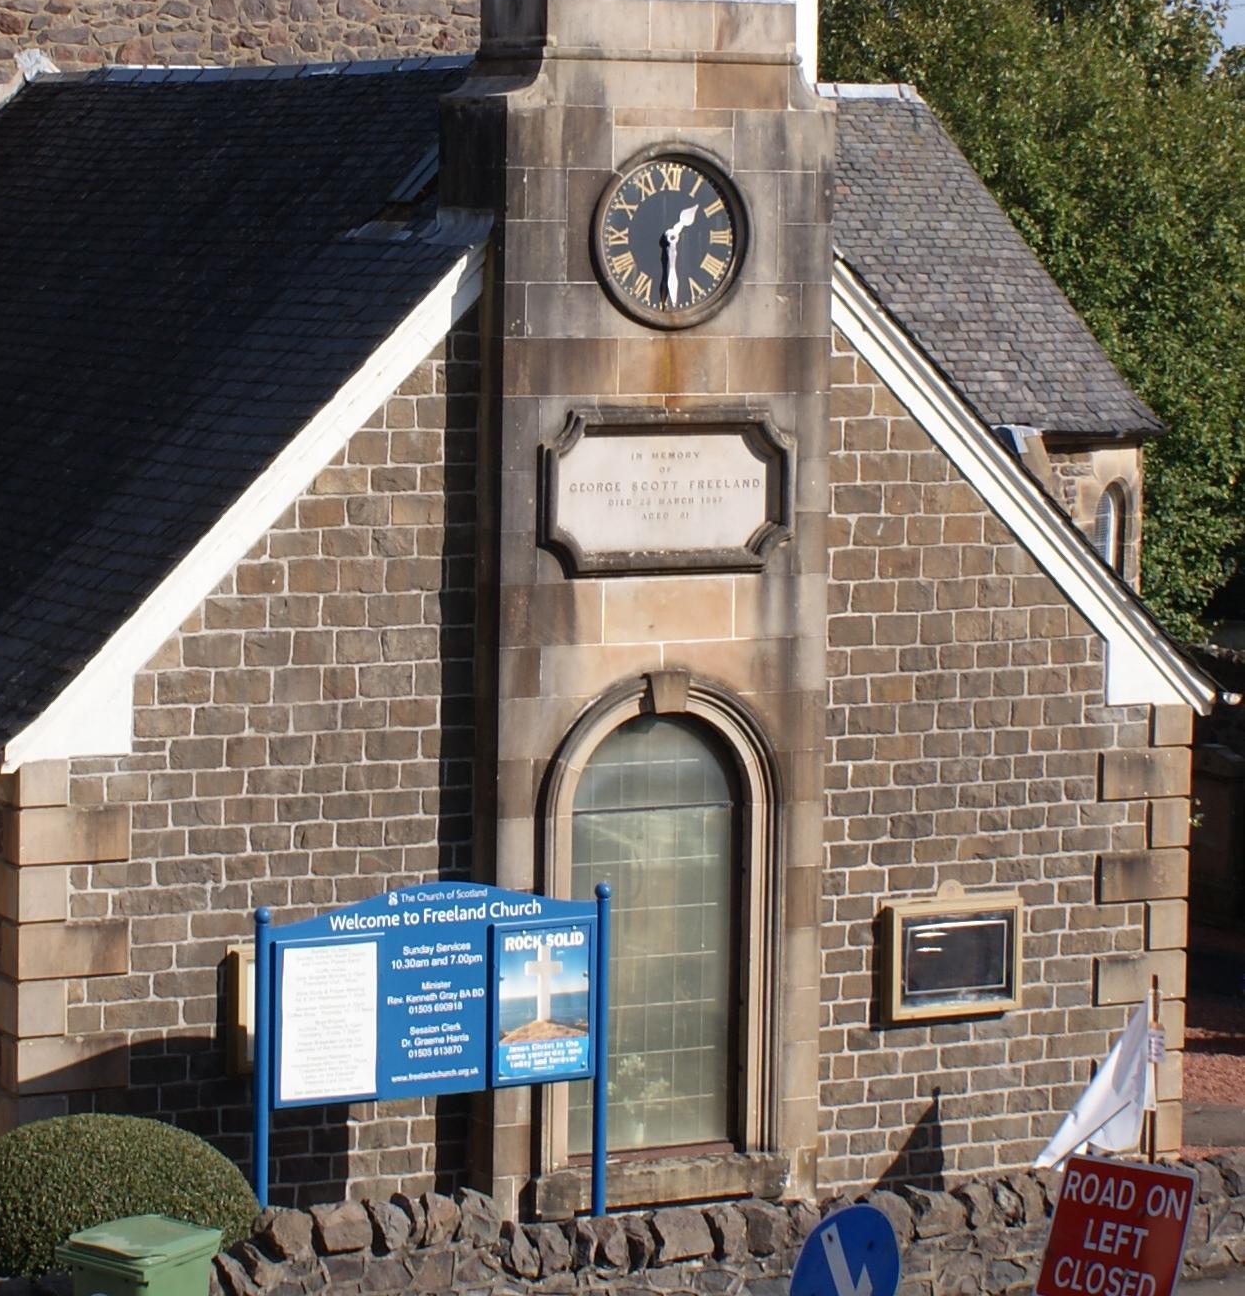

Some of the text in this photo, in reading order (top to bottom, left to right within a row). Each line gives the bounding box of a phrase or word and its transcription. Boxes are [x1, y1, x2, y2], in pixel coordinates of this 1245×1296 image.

[634, 169, 657, 202] XI
[659, 167, 683, 192] XII
[611, 193, 638, 220] X
[704, 198, 724, 218] II
[710, 228, 733, 246] III
[630, 450, 700, 461] IN MEMORY
[658, 466, 672, 474] OF
[568, 480, 622, 493] GEORGE
[631, 480, 680, 492] SCOTT
[608, 498, 633, 507] DIED
[658, 496, 695, 506] MARCH
[641, 511, 670, 521] AGED
[400, 888, 488, 903] The Church of Scotland
[330, 899, 541, 931] Welcome to Freeland Church
[403, 941, 471, 956] Sunday Services
[505, 931, 584, 952] ROCK SOLID
[391, 953, 483, 970] 10.30am and 7.00pm
[421, 981, 451, 990] Minister
[459, 989, 471, 998] BA
[472, 988, 484, 997] BD
[1063, 1170, 1187, 1221] ROAD ON
[1083, 1218, 1149, 1259] LEFT
[1054, 1256, 1156, 1296] CLOSED
